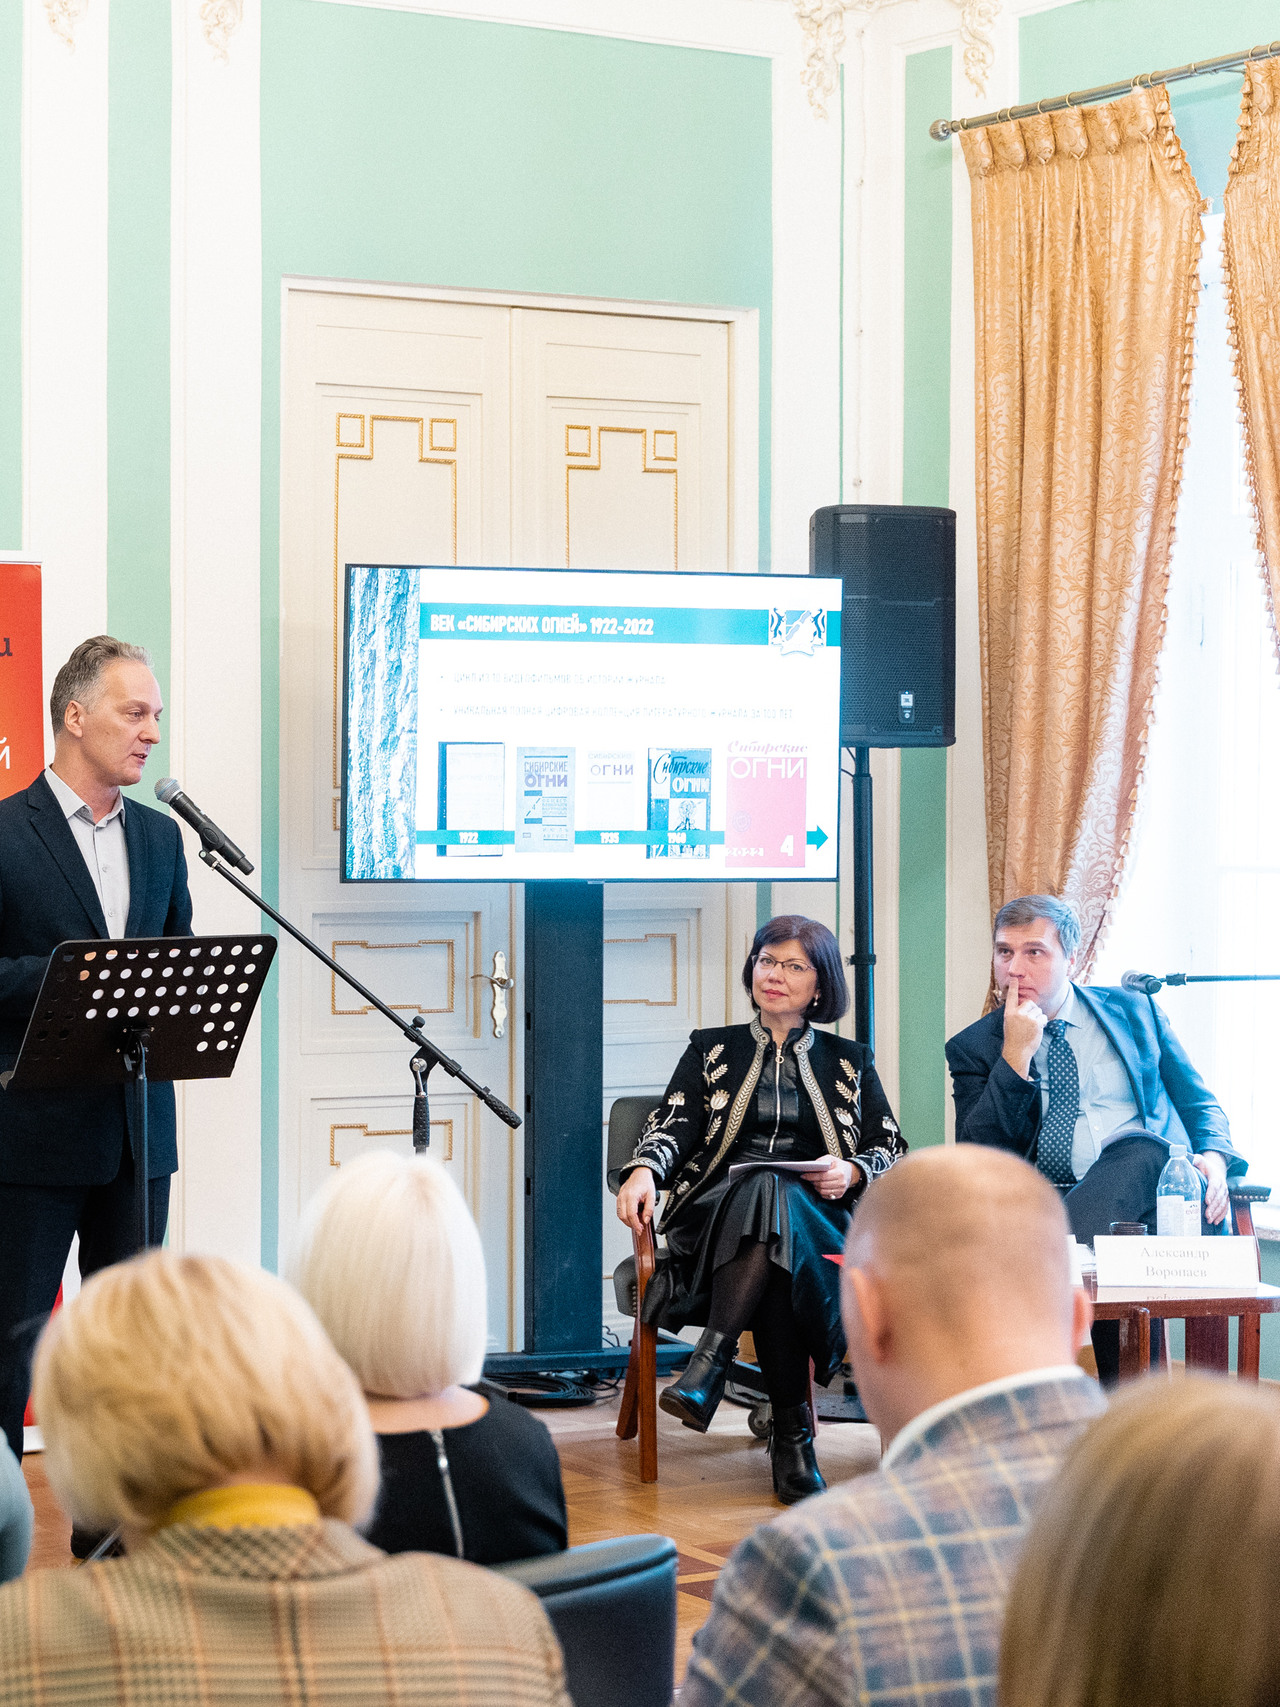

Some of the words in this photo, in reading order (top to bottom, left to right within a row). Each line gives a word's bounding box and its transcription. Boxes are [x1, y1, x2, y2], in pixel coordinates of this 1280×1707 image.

[430, 614, 455, 631] ВЕК
[457, 614, 539, 633] «СИБИРСКИХ
[541, 613, 588, 634] ОГНЕЙ»
[590, 617, 654, 635] 1922-2022
[727, 740, 808, 754] Сибирские
[524, 761, 568, 773] СИБИРСКИЕ
[590, 764, 634, 776] ОГНИ
[653, 752, 709, 784] Сибирские
[730, 758, 804, 779] ОГНИ
[524, 774, 568, 788] ОГНИ
[672, 777, 711, 793] ОГНИ
[459, 831, 478, 844] 1922
[780, 834, 794, 857] 4
[1141, 1247, 1210, 1261] Александр
